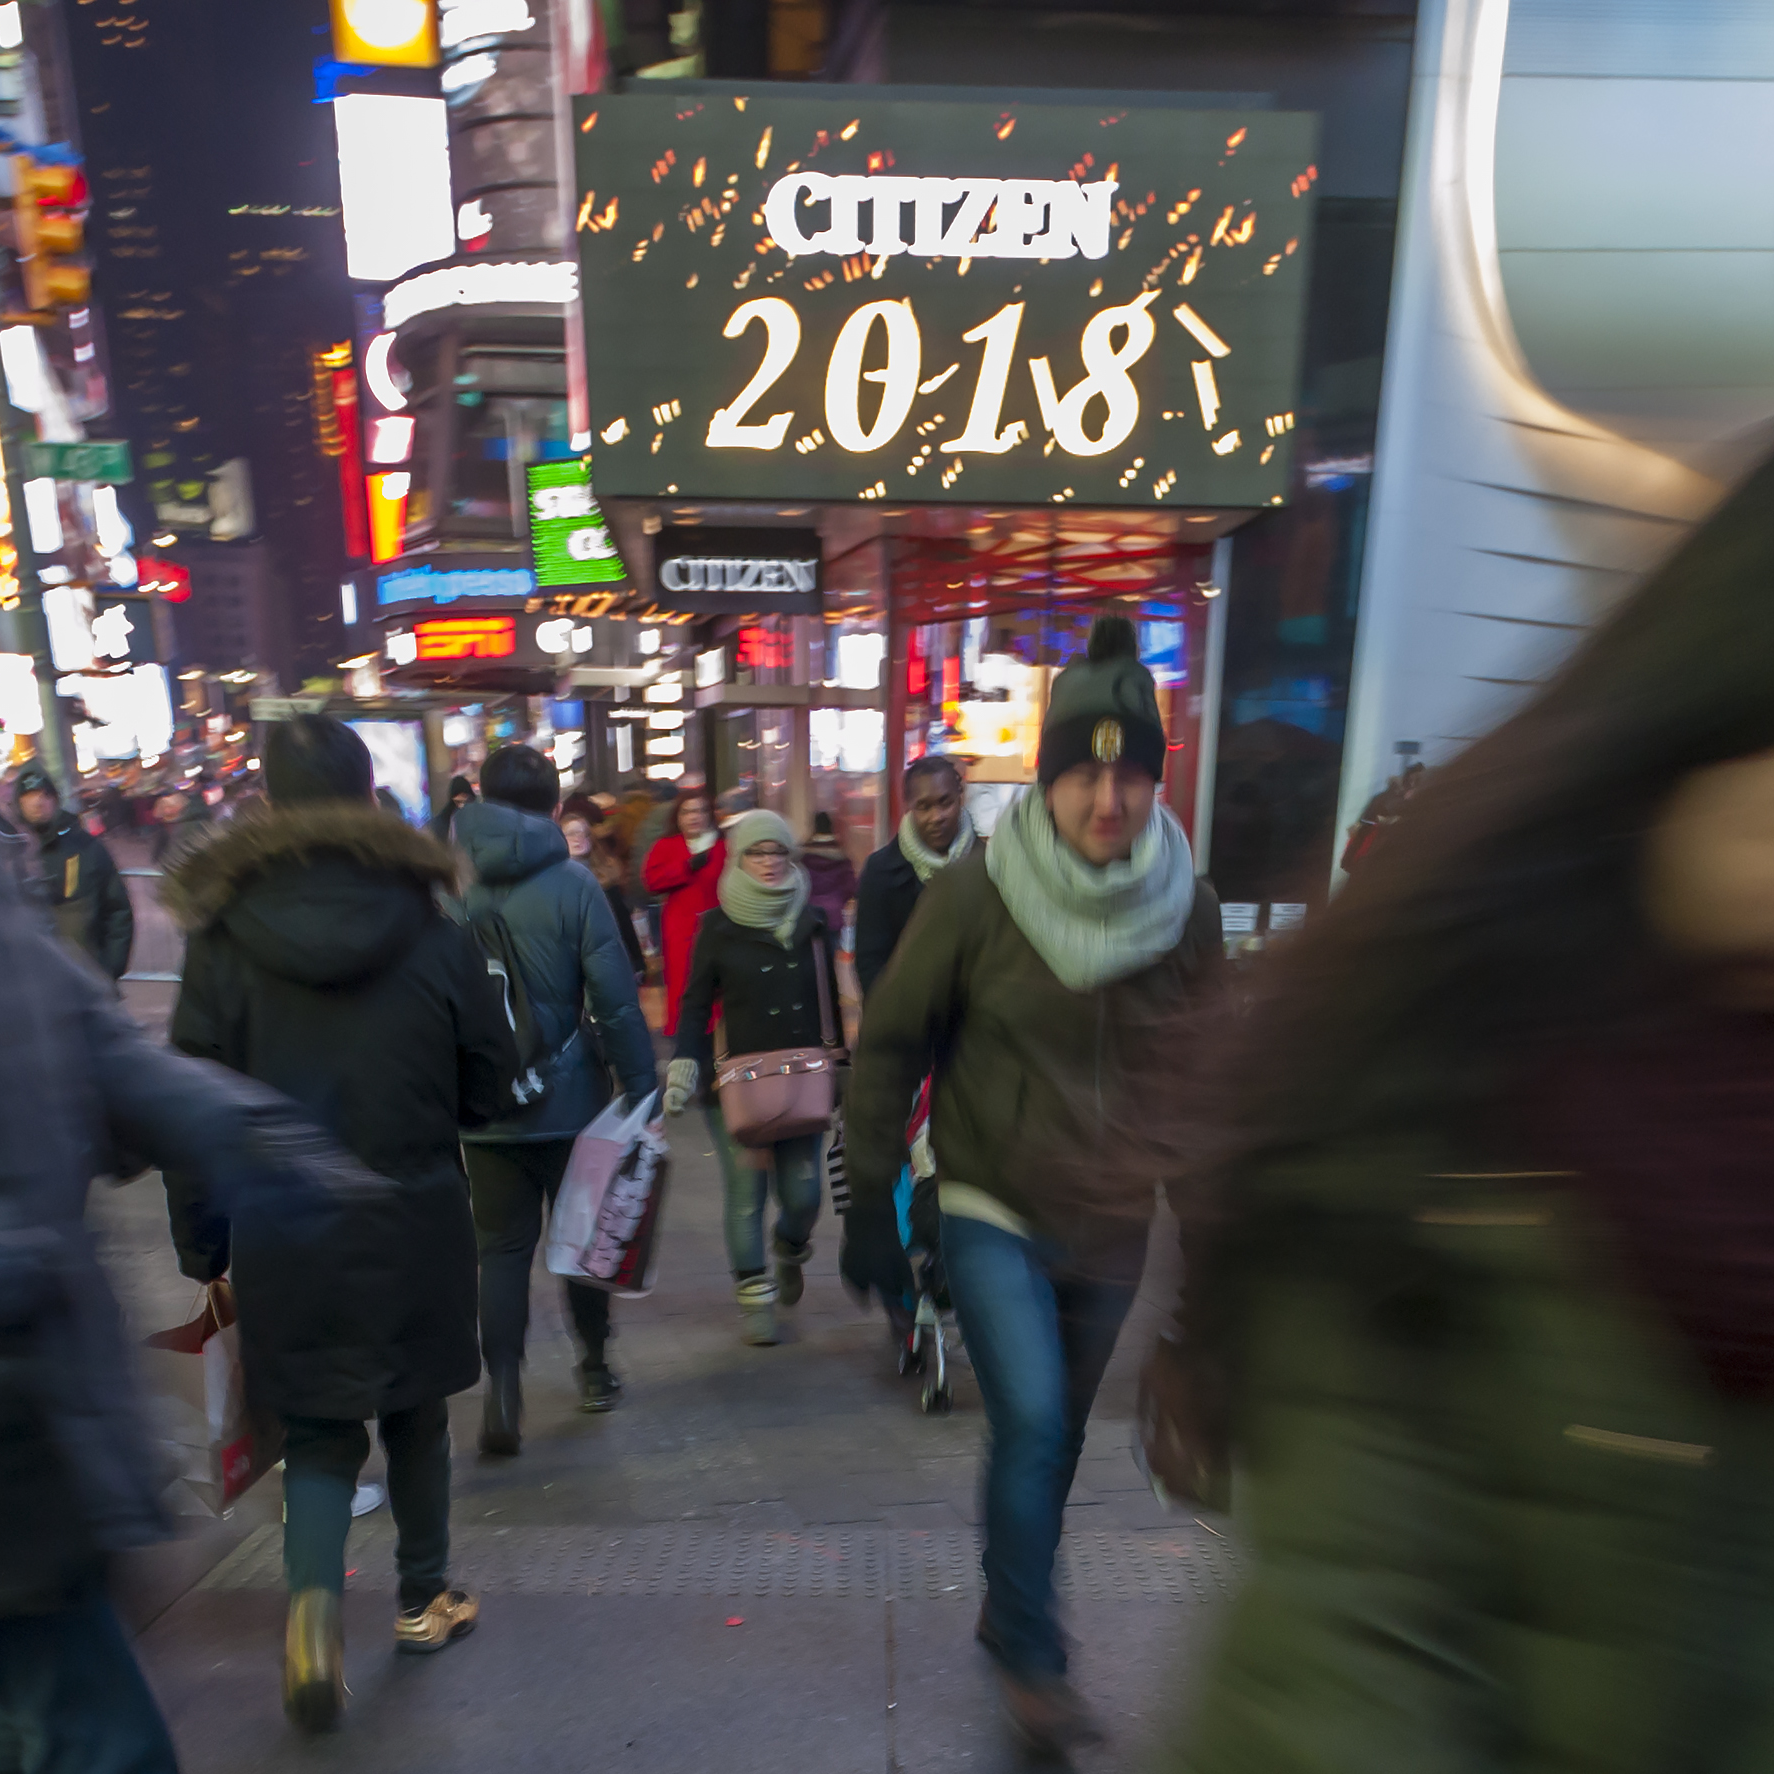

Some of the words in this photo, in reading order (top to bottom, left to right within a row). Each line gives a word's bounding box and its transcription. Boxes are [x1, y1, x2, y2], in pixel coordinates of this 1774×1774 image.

[764, 171, 1119, 260] CITIZEN
[706, 297, 1156, 456] 2018
[659, 555, 818, 593] CITIZEN
